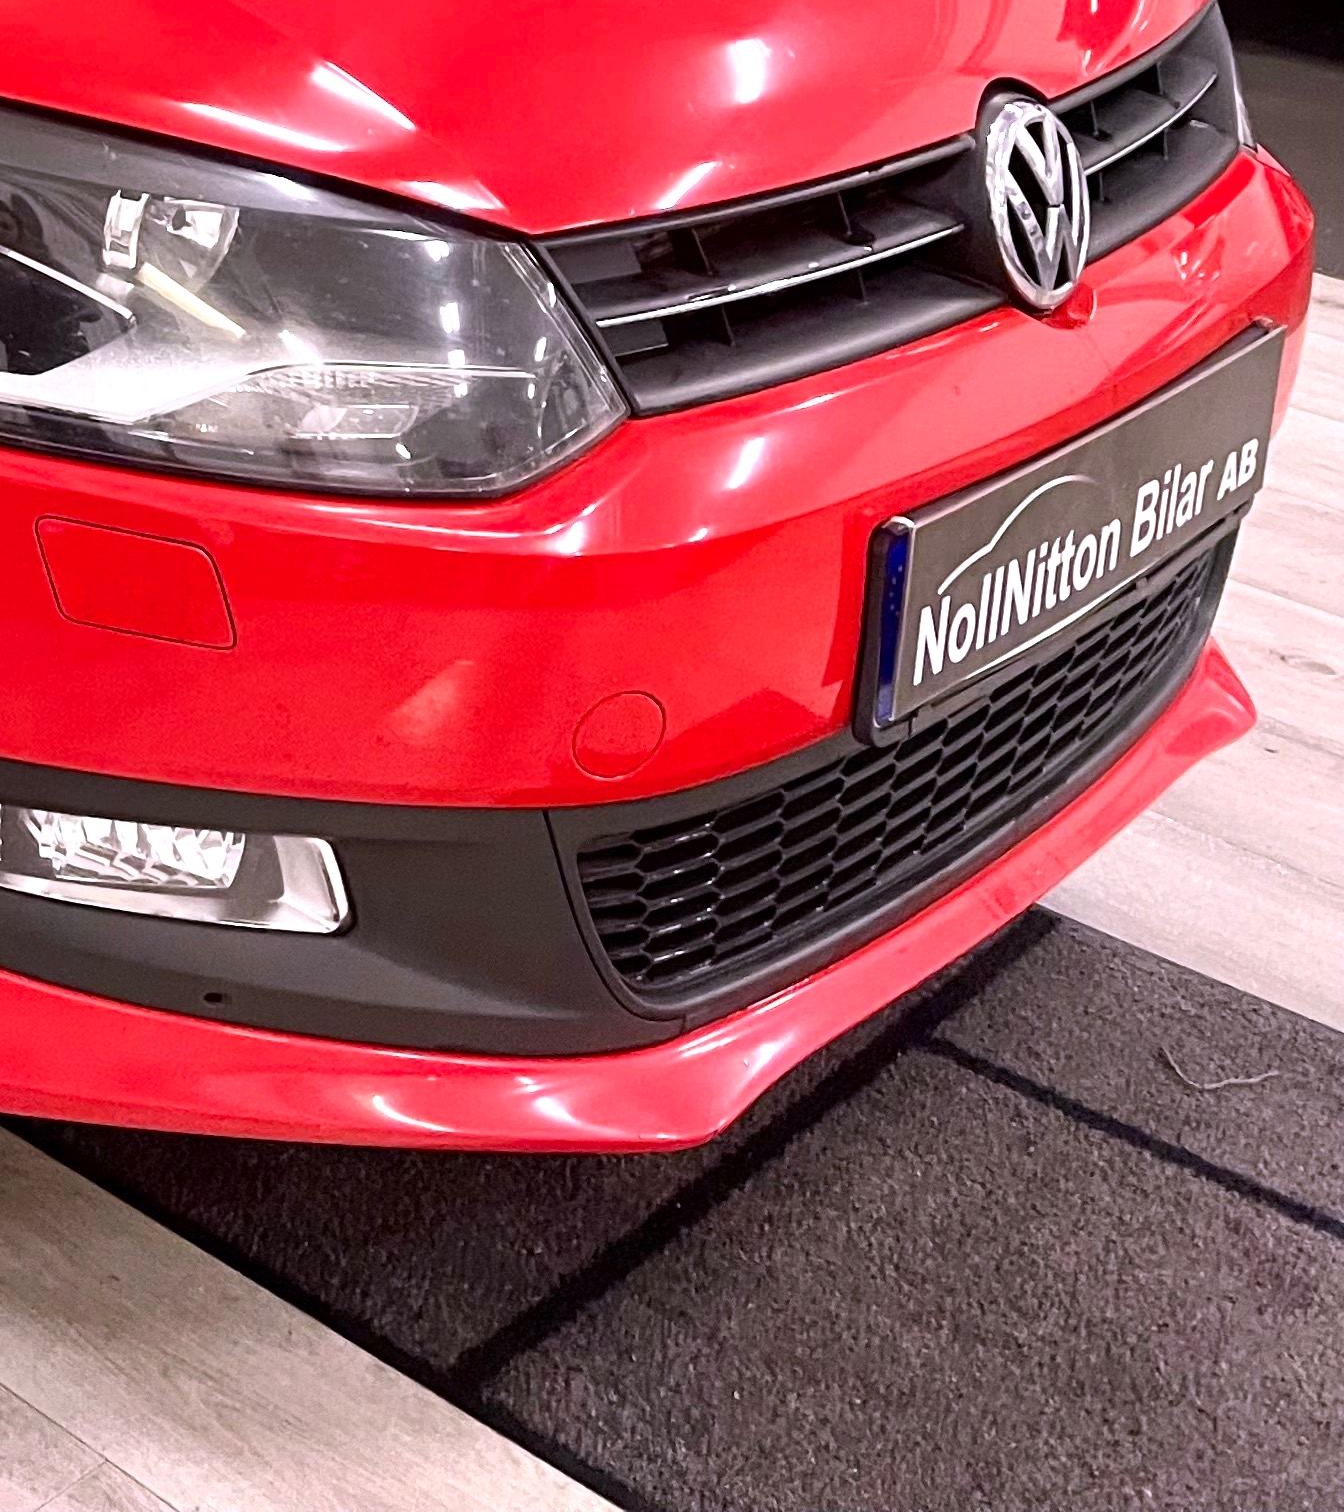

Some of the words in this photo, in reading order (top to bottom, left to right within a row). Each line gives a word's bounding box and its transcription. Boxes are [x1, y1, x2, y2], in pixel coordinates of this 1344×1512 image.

[912, 518, 1122, 686] NollNitton
[1130, 458, 1215, 558] Bilar
[1216, 437, 1260, 502] AB
